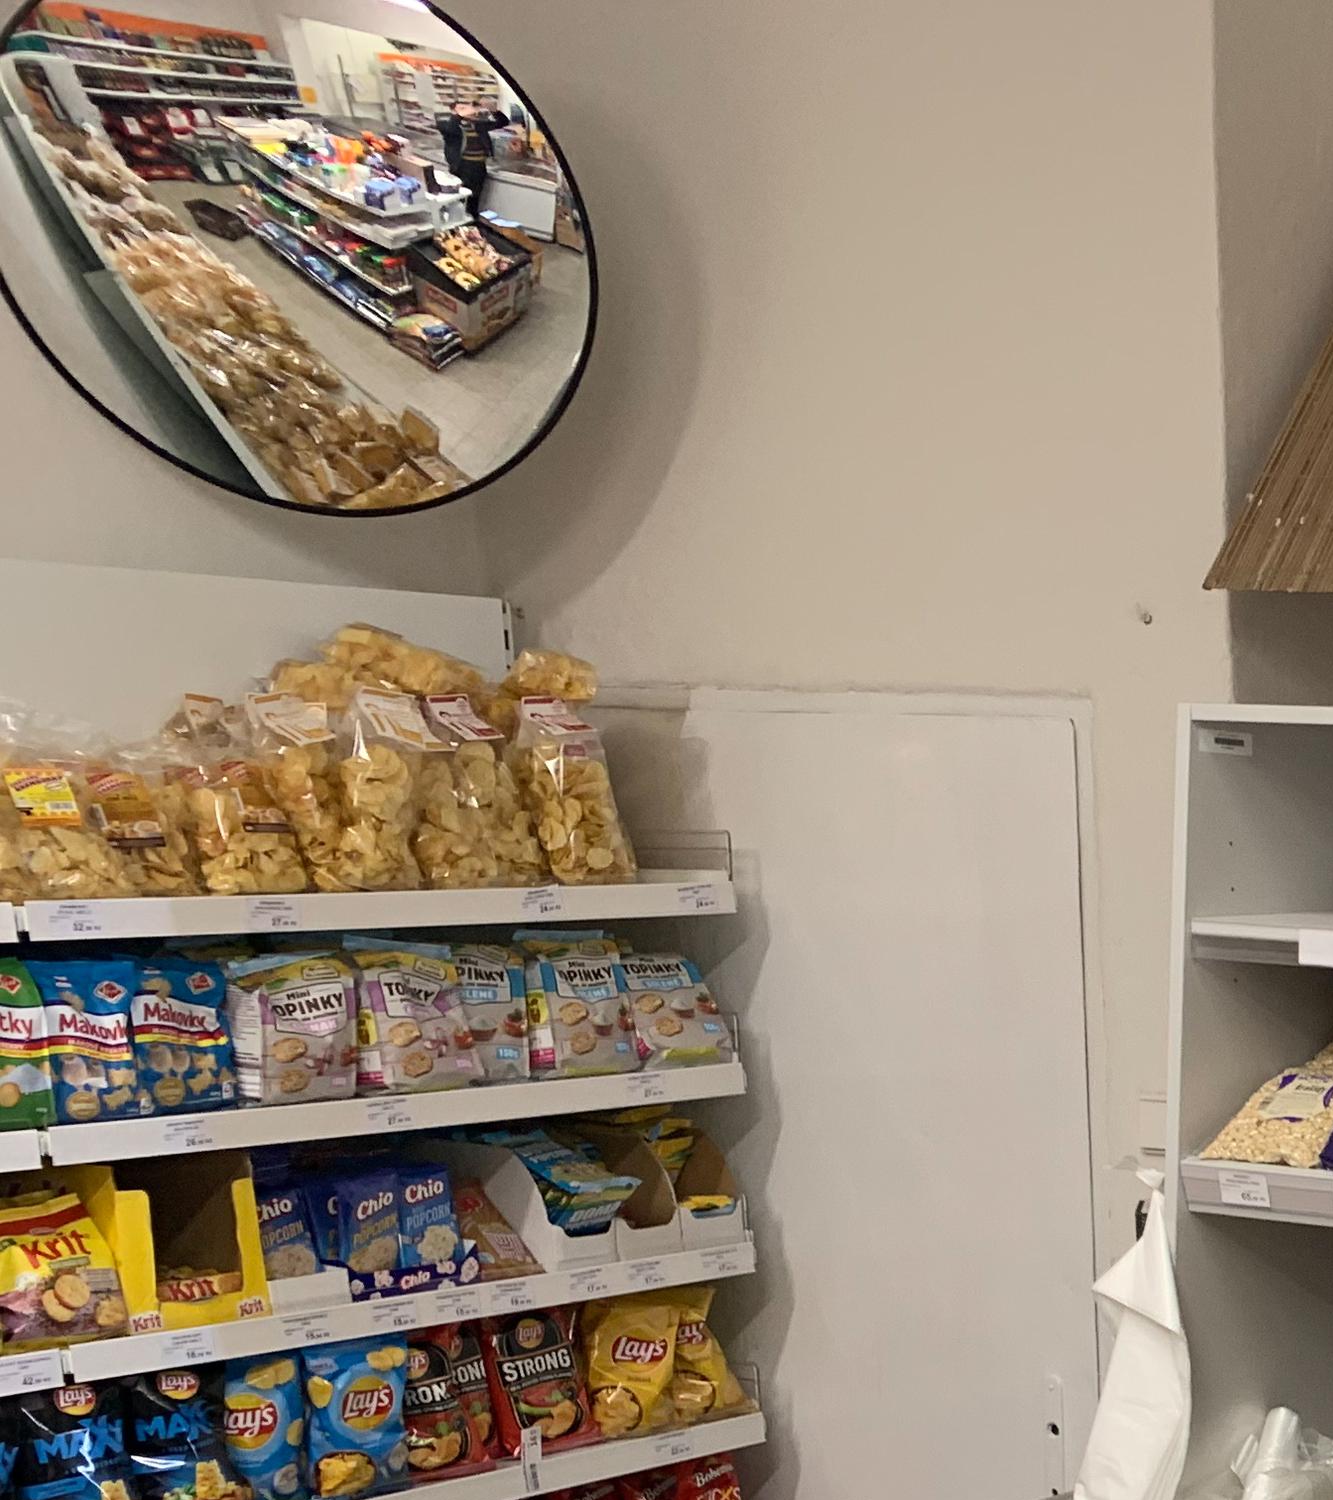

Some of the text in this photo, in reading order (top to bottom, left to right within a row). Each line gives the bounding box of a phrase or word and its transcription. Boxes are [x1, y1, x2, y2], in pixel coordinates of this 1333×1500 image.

[405, 1178, 444, 1204] Chio
[19, 1229, 92, 1270] Krit
[167, 1277, 218, 1301] Krit
[500, 1348, 572, 1384] STRONG
